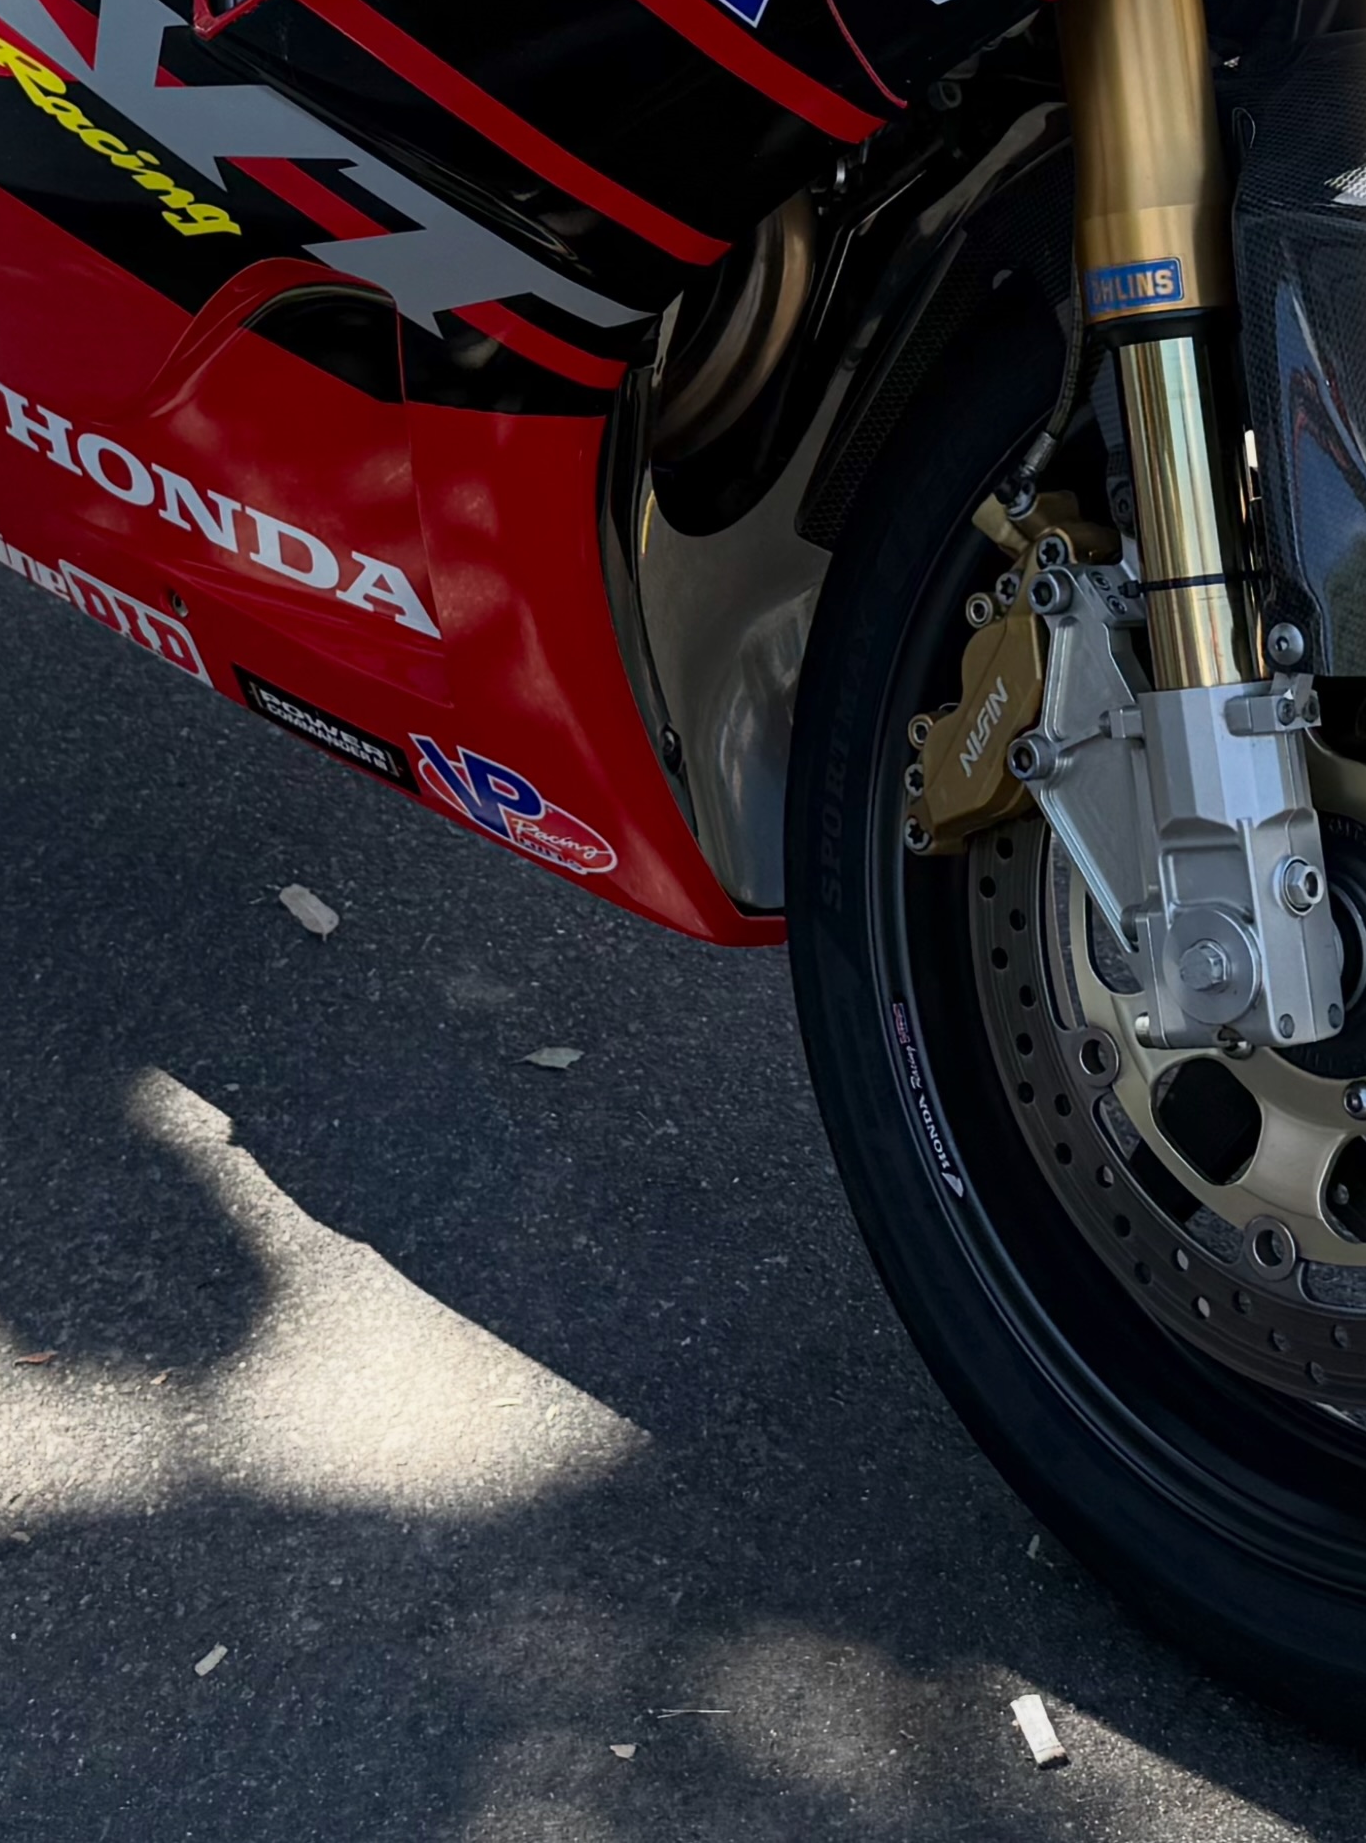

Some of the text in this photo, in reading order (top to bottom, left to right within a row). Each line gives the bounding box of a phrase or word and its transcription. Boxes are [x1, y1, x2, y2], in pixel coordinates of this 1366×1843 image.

[259, 688, 388, 763] POWER
[266, 703, 372, 764] COMMANDER
[959, 674, 1009, 779] NISSIN
[407, 732, 545, 841] VP
[510, 817, 613, 860] Racing
[920, 1094, 950, 1169] HONDA
